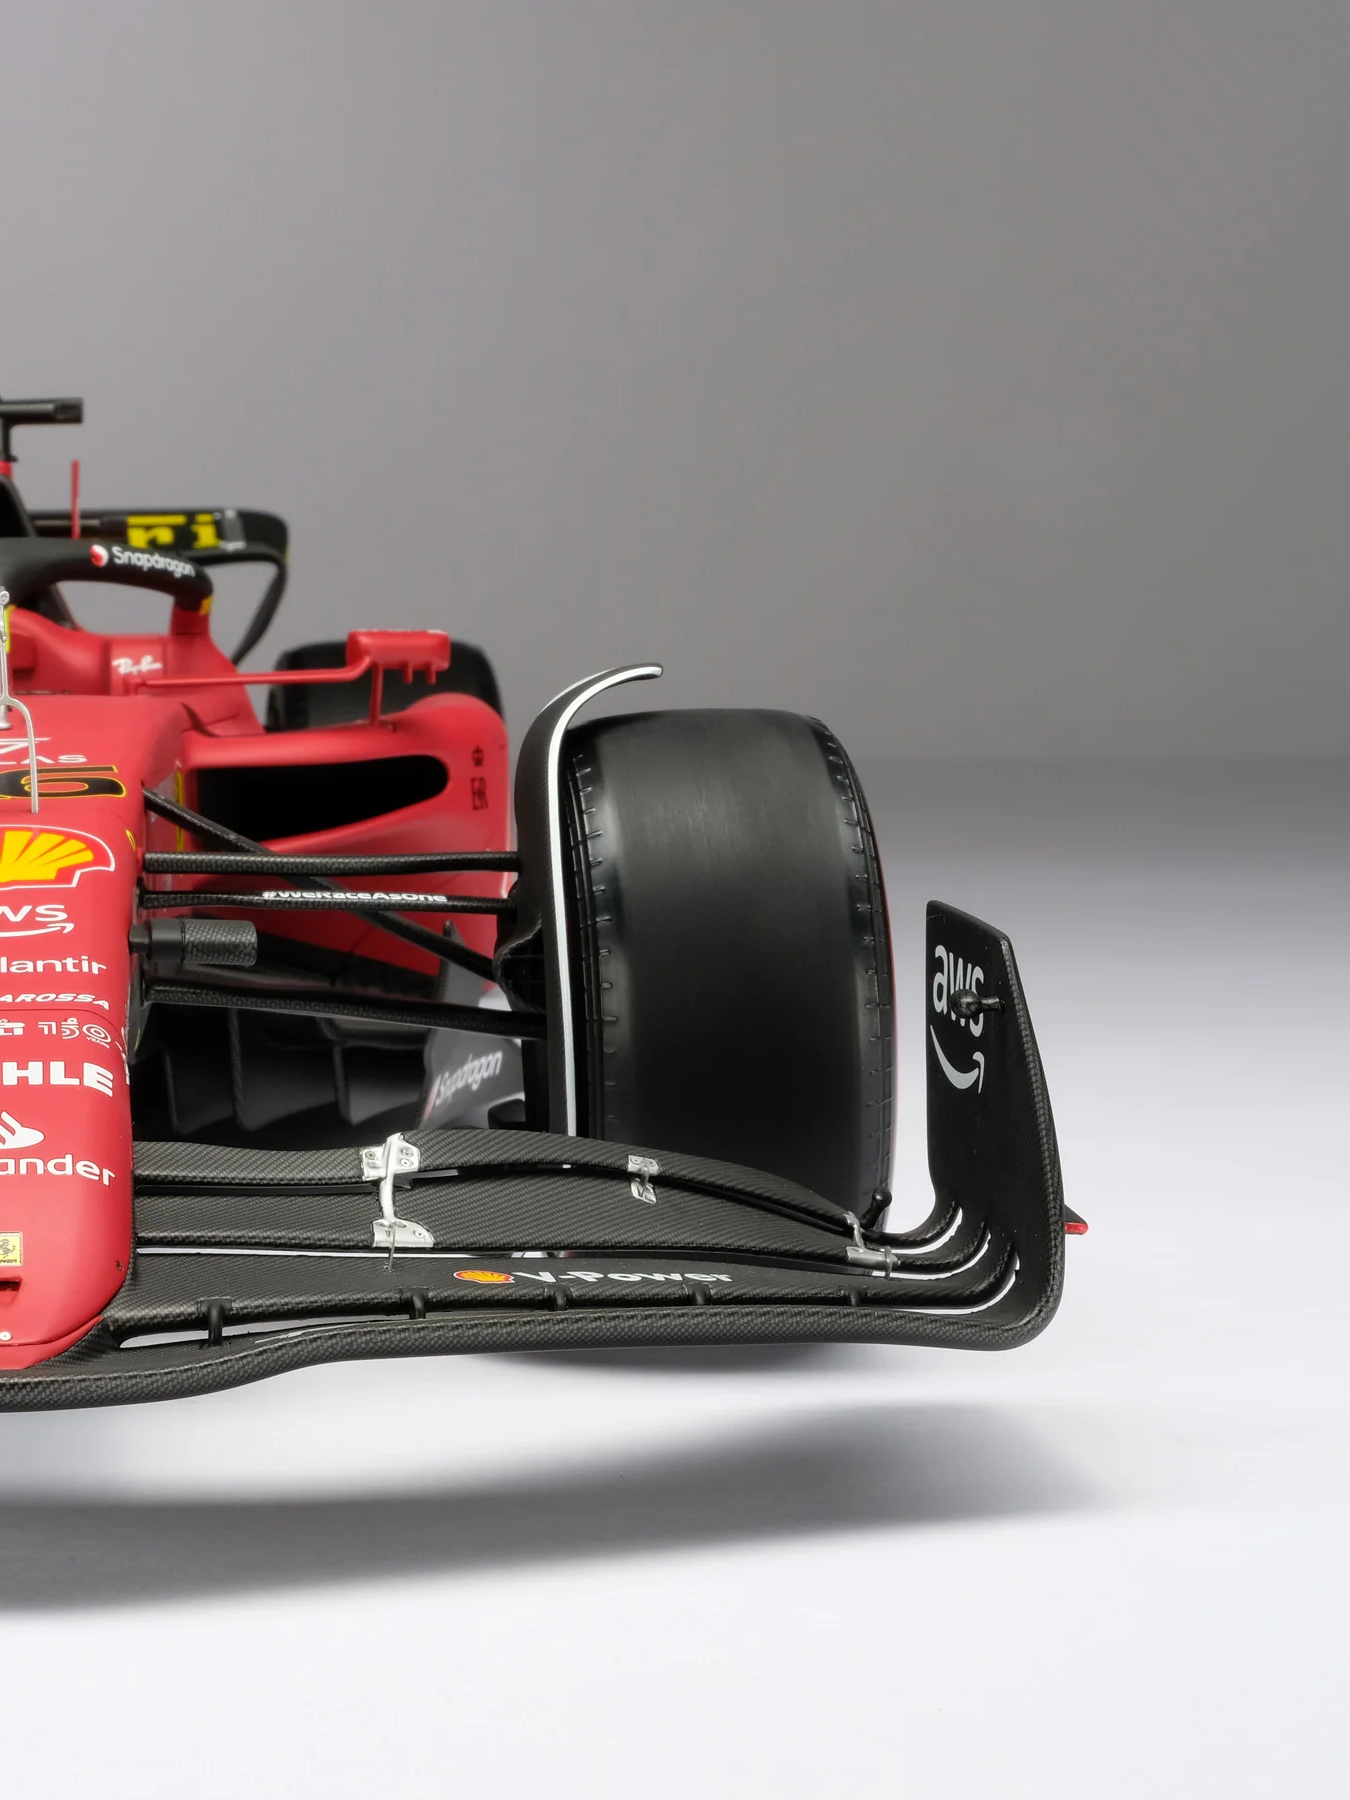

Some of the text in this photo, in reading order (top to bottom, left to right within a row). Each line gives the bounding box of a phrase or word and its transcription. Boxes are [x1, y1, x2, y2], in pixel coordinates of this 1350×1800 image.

[111, 546, 196, 578] Snapdragon
[261, 890, 448, 902] #WeRaceAsOne
[932, 944, 986, 1038] aws
[511, 1270, 733, 1283] V-Power
